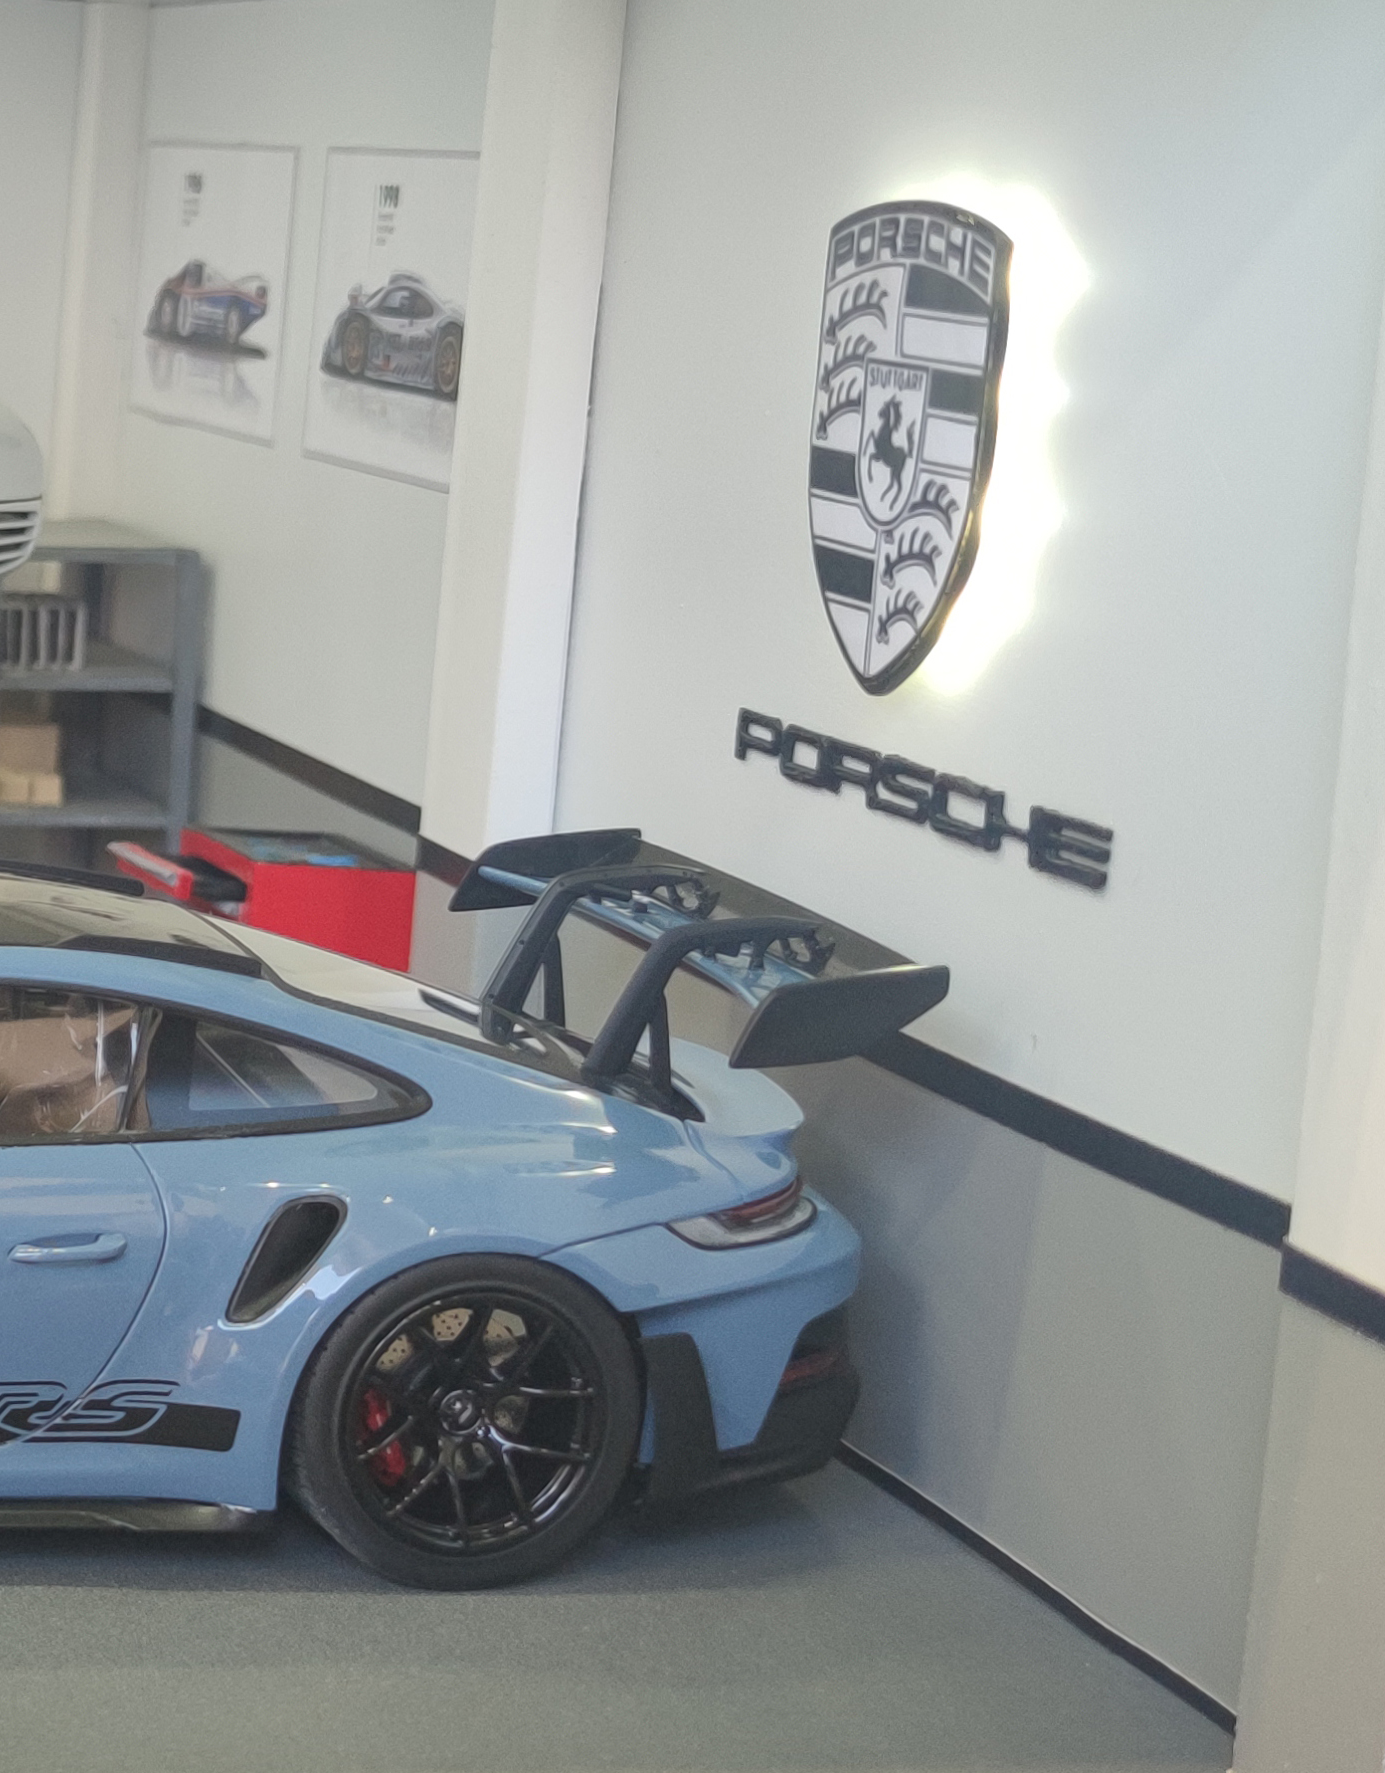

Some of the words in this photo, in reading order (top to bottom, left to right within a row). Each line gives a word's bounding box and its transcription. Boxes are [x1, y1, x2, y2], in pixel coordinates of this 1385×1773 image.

[828, 216, 995, 301] PORSCHE
[868, 366, 925, 392] STUTTGART
[734, 706, 1114, 890] PORSCHE
